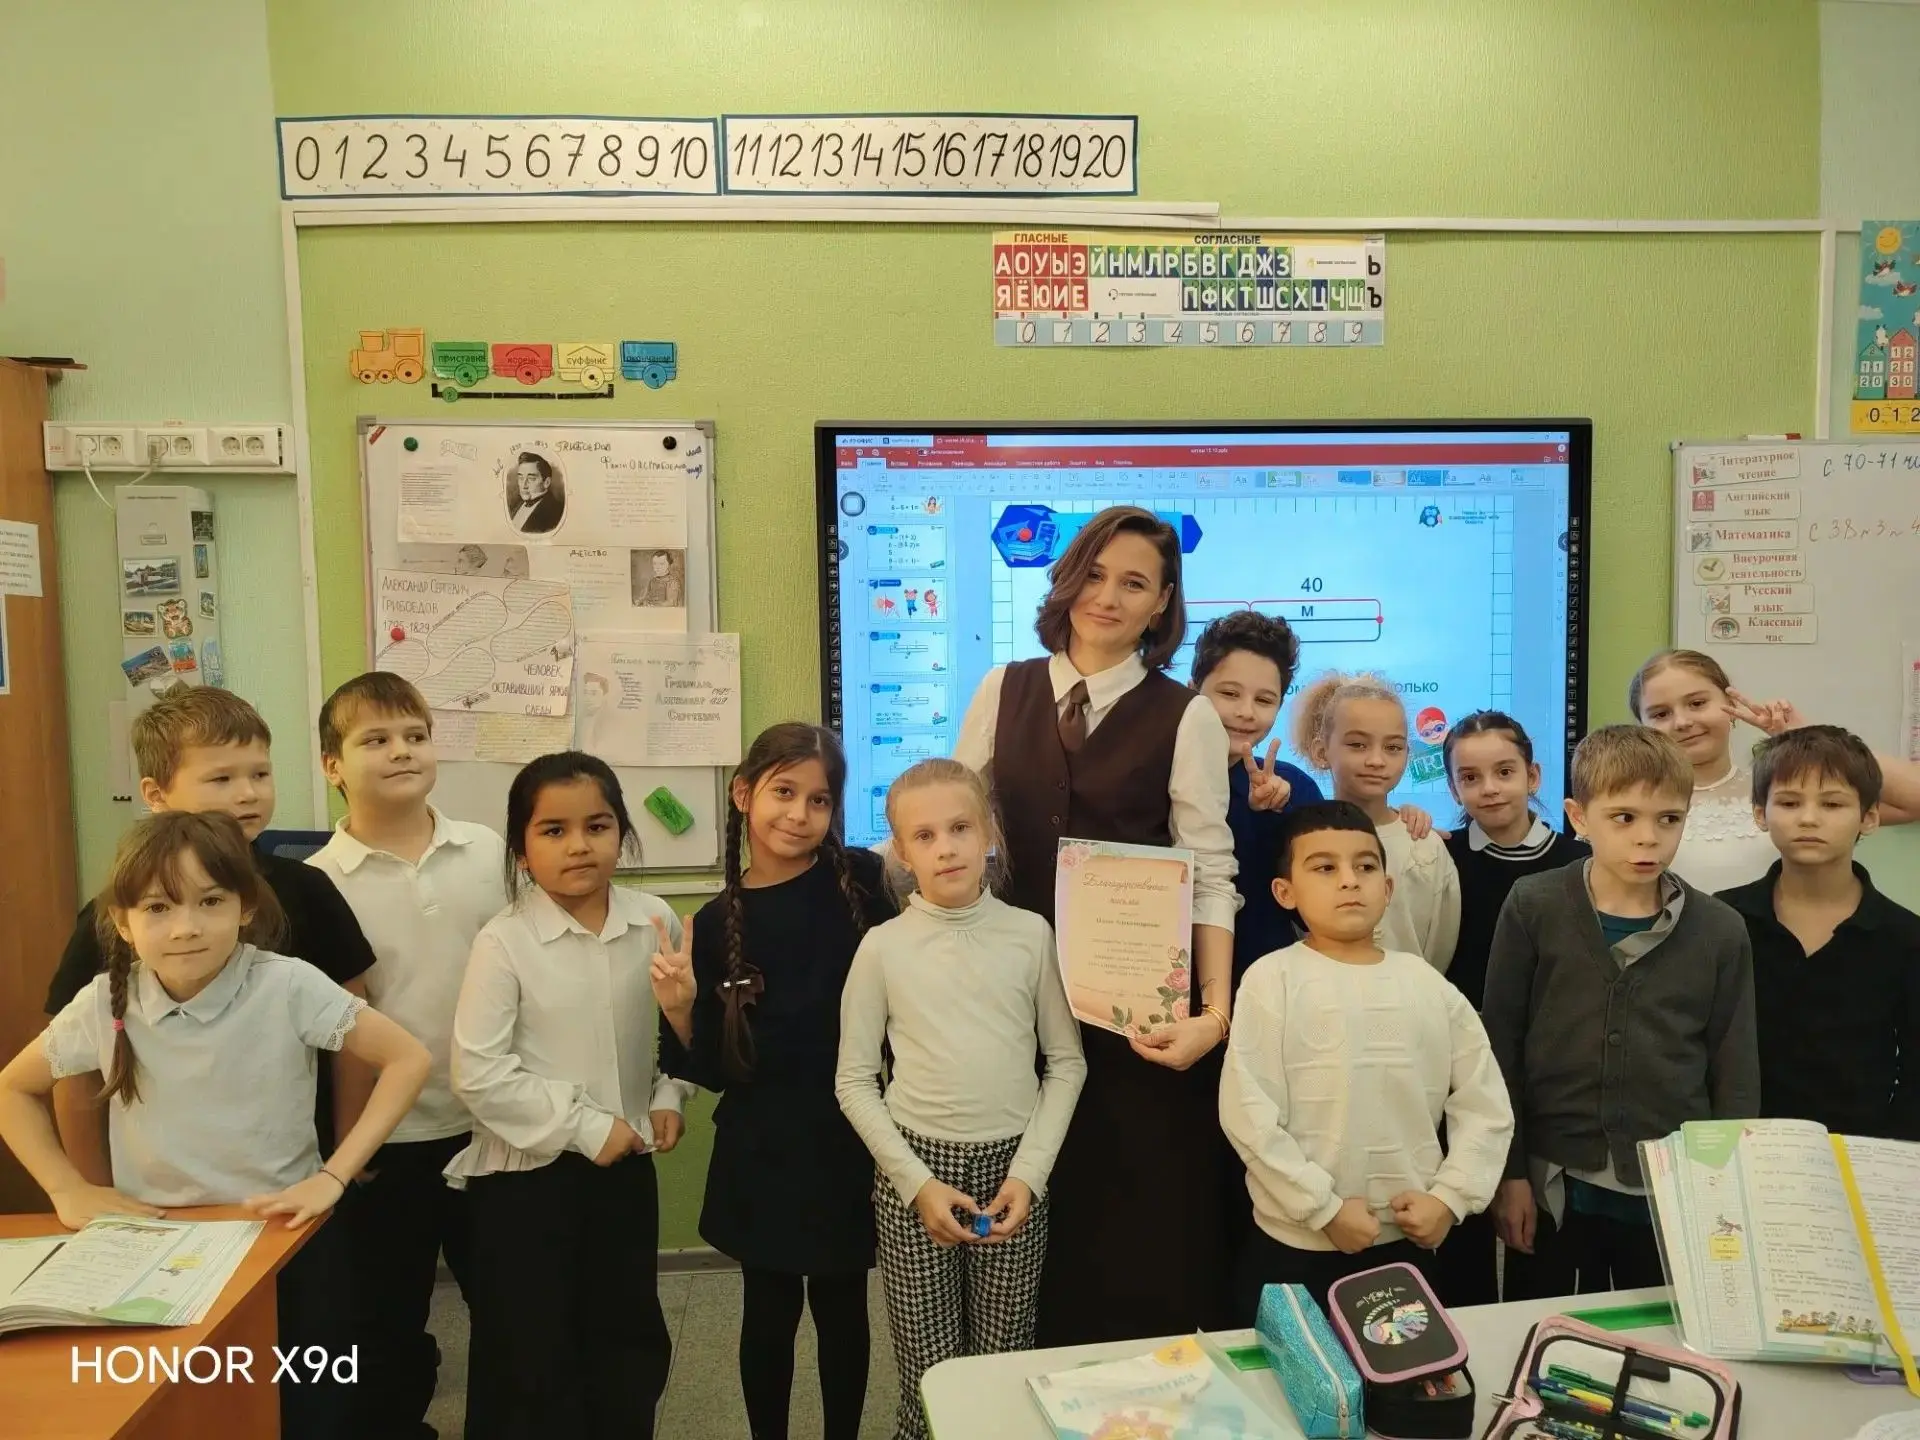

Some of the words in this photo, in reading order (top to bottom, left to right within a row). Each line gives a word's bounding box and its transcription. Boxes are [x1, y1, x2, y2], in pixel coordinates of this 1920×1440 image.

[295, 136, 320, 181] 0
[335, 134, 349, 179] 1
[363, 134, 388, 179] 2
[406, 133, 428, 178] 3
[443, 134, 467, 178] 4
[486, 134, 511, 178] 5
[525, 133, 550, 178] 6
[561, 133, 586, 177] 7
[598, 134, 622, 176] 8
[635, 135, 660, 177] 9
[670, 136, 708, 179] 10
[734, 133, 763, 176] 11
[769, 133, 803, 177] 12
[810, 133, 843, 177] 13
[851, 132, 883, 177] 14
[892, 132, 926, 177] 15
[933, 132, 967, 177] 16
[973, 132, 1008, 177] 17
[1012, 133, 1045, 178] 18
[1049, 134, 1082, 178] 19
[1082, 134, 1126, 178] 20
[1014, 233, 1068, 243] ГЛАСНЫЕ
[1194, 235, 1261, 245] СОГЛАСНЫЕ
[1022, 321, 1035, 342] 0
[1063, 322, 1072, 342] 1
[1095, 321, 1110, 343] 2
[1133, 322, 1146, 342] 3
[1170, 322, 1182, 342] 4
[1204, 322, 1218, 342] 5
[1242, 322, 1255, 342] 6
[1278, 322, 1291, 343] 7
[1314, 322, 1327, 343] 8
[1351, 322, 1362, 342] 9
[566, 355, 608, 365] суффикс
[1869, 407, 1880, 423] 0
[1892, 407, 1899, 422] 1
[1738, 470, 1776, 480] чтение
[1716, 529, 1791, 541] Математика
[1301, 577, 1323, 592] 40
[1744, 585, 1792, 597] Русский
[1753, 604, 1784, 613] язык
[1748, 616, 1803, 627] Классный
[1765, 634, 1784, 642] час
[1362, 1286, 1394, 1305] MEOW
